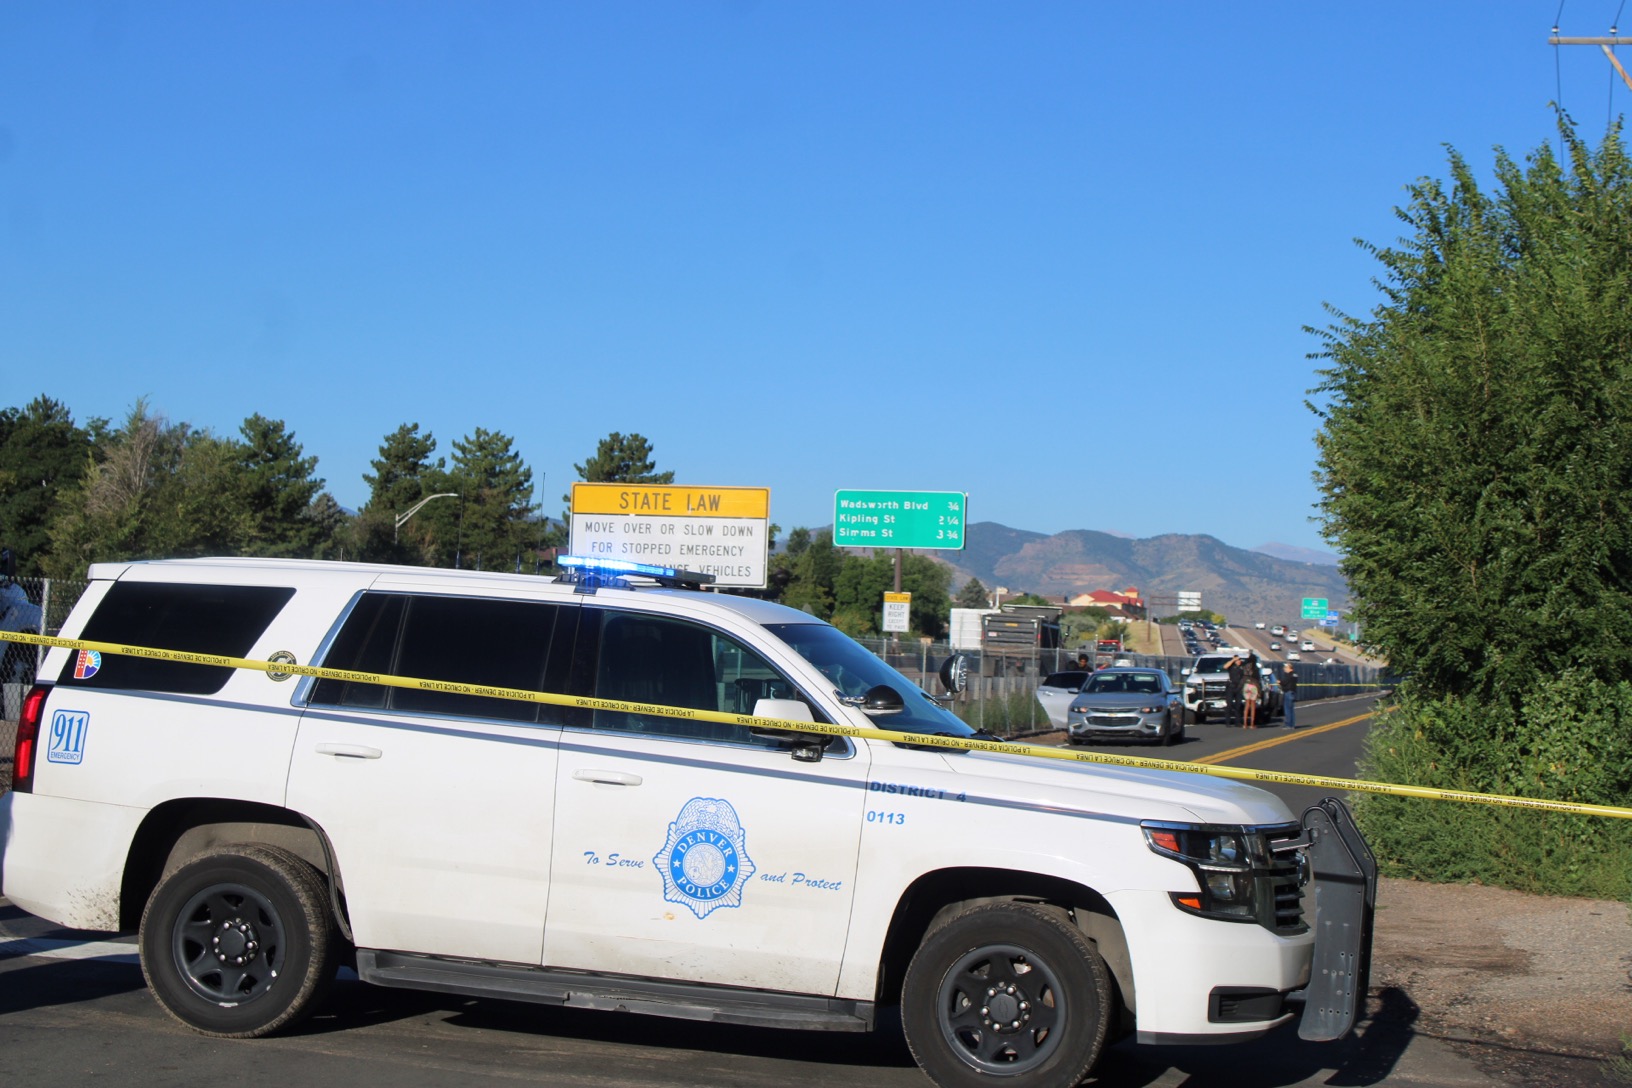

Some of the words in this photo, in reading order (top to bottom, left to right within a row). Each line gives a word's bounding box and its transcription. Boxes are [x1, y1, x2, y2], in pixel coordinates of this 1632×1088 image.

[619, 492, 672, 510] STATE
[688, 494, 721, 511] LAW
[840, 500, 899, 510] Wadsworth
[904, 501, 928, 510] Blvd
[839, 514, 878, 525] Kipling
[883, 515, 895, 523] St
[939, 516, 944, 525] 2
[585, 522, 614, 533] MOVE
[624, 523, 651, 534] OVER
[661, 524, 674, 534] OR
[684, 525, 714, 535] SLOW
[723, 526, 753, 536] DOWN
[839, 528, 876, 537] Simms
[881, 529, 893, 537] St
[936, 530, 944, 539] 3
[592, 542, 612, 553] FOR
[622, 542, 671, 554] STOPPED
[680, 544, 744, 556] EMERGENCY
[699, 565, 751, 577] VEHICLES
[121, 646, 135, 654] LINEA
[144, 649, 161, 657] CRUCE
[173, 652, 194, 661] DENVER
[195, 654, 202, 662] DE
[203, 655, 222, 664] POLICIA
[268, 663, 282, 671] LINEA
[283, 664, 290, 672] LA
[291, 665, 308, 674] CRUCE
[309, 667, 317, 675] NO
[321, 669, 342, 678] DENVER
[343, 671, 351, 679] DE
[351, 672, 371, 681] POLICIA
[419, 680, 434, 689] LINEA
[435, 682, 442, 690] LA
[444, 682, 461, 692] CRUCE
[462, 685, 471, 693] NO
[474, 686, 496, 696] DENVER
[497, 689, 505, 697] DE
[506, 690, 526, 699] POLICIA
[527, 692, 535, 700] LA
[576, 697, 591, 706] LINEA
[592, 699, 600, 707] LA
[601, 700, 619, 709] CRUCE
[620, 702, 629, 711] NO
[632, 704, 655, 714] DENVER
[656, 706, 664, 715] DE
[665, 707, 686, 717] POLICIA
[687, 710, 694, 718] LA
[736, 715, 752, 724] LINEA
[754, 717, 761, 725] LA
[762, 718, 781, 728] CRUCE
[782, 720, 791, 729] NO
[795, 722, 819, 732] DENVER
[820, 725, 828, 733] DE
[52, 714, 84, 752] 911
[829, 726, 851, 735] POLICIA
[851, 728, 859, 736] LA
[903, 734, 920, 742] LINEA
[921, 735, 929, 743] LA
[930, 736, 949, 746] CRUCE
[951, 739, 960, 747] NO
[964, 740, 988, 750] DENVER
[989, 743, 998, 751] DE
[999, 744, 1021, 753] POLICIA
[1022, 746, 1030, 754] LA
[51, 752, 80, 760] EMERGENCY
[1076, 752, 1093, 761] LINEA
[1094, 754, 1102, 762] LA
[1104, 755, 1124, 765] CRUCE
[1125, 757, 1134, 766] NO
[1139, 759, 1164, 769] DENVER
[1165, 762, 1174, 770] DE
[1175, 763, 1198, 772] POLICIA
[1199, 765, 1207, 773] LA
[870, 781, 947, 799] DISTRICT
[956, 792, 966, 802] 4
[867, 811, 905, 825] 0113
[677, 832, 733, 858] DENVER
[584, 851, 599, 864] To
[606, 853, 644, 868] Serve
[760, 872, 787, 883] and
[792, 872, 842, 890] Protect
[678, 876, 729, 897] POLICE
